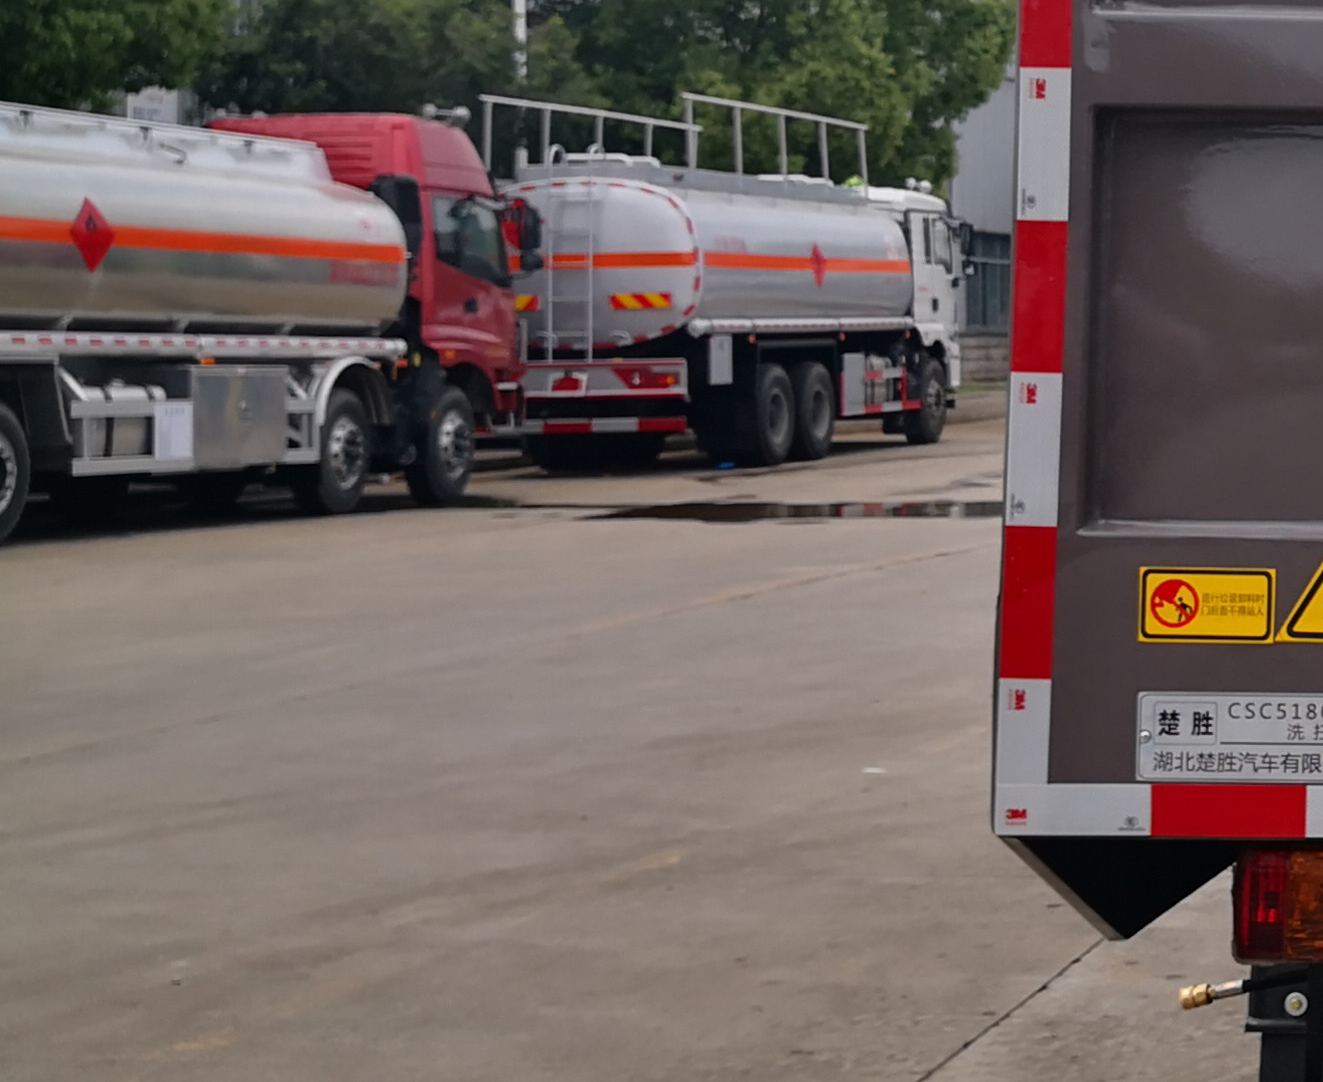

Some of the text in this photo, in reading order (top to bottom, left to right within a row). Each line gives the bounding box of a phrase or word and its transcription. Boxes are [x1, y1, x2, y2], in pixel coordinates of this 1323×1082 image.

[1035, 78, 1046, 99] 3M
[1026, 383, 1037, 404] 3M
[1014, 689, 1026, 711] 3M
[1006, 808, 1027, 820] 3M
